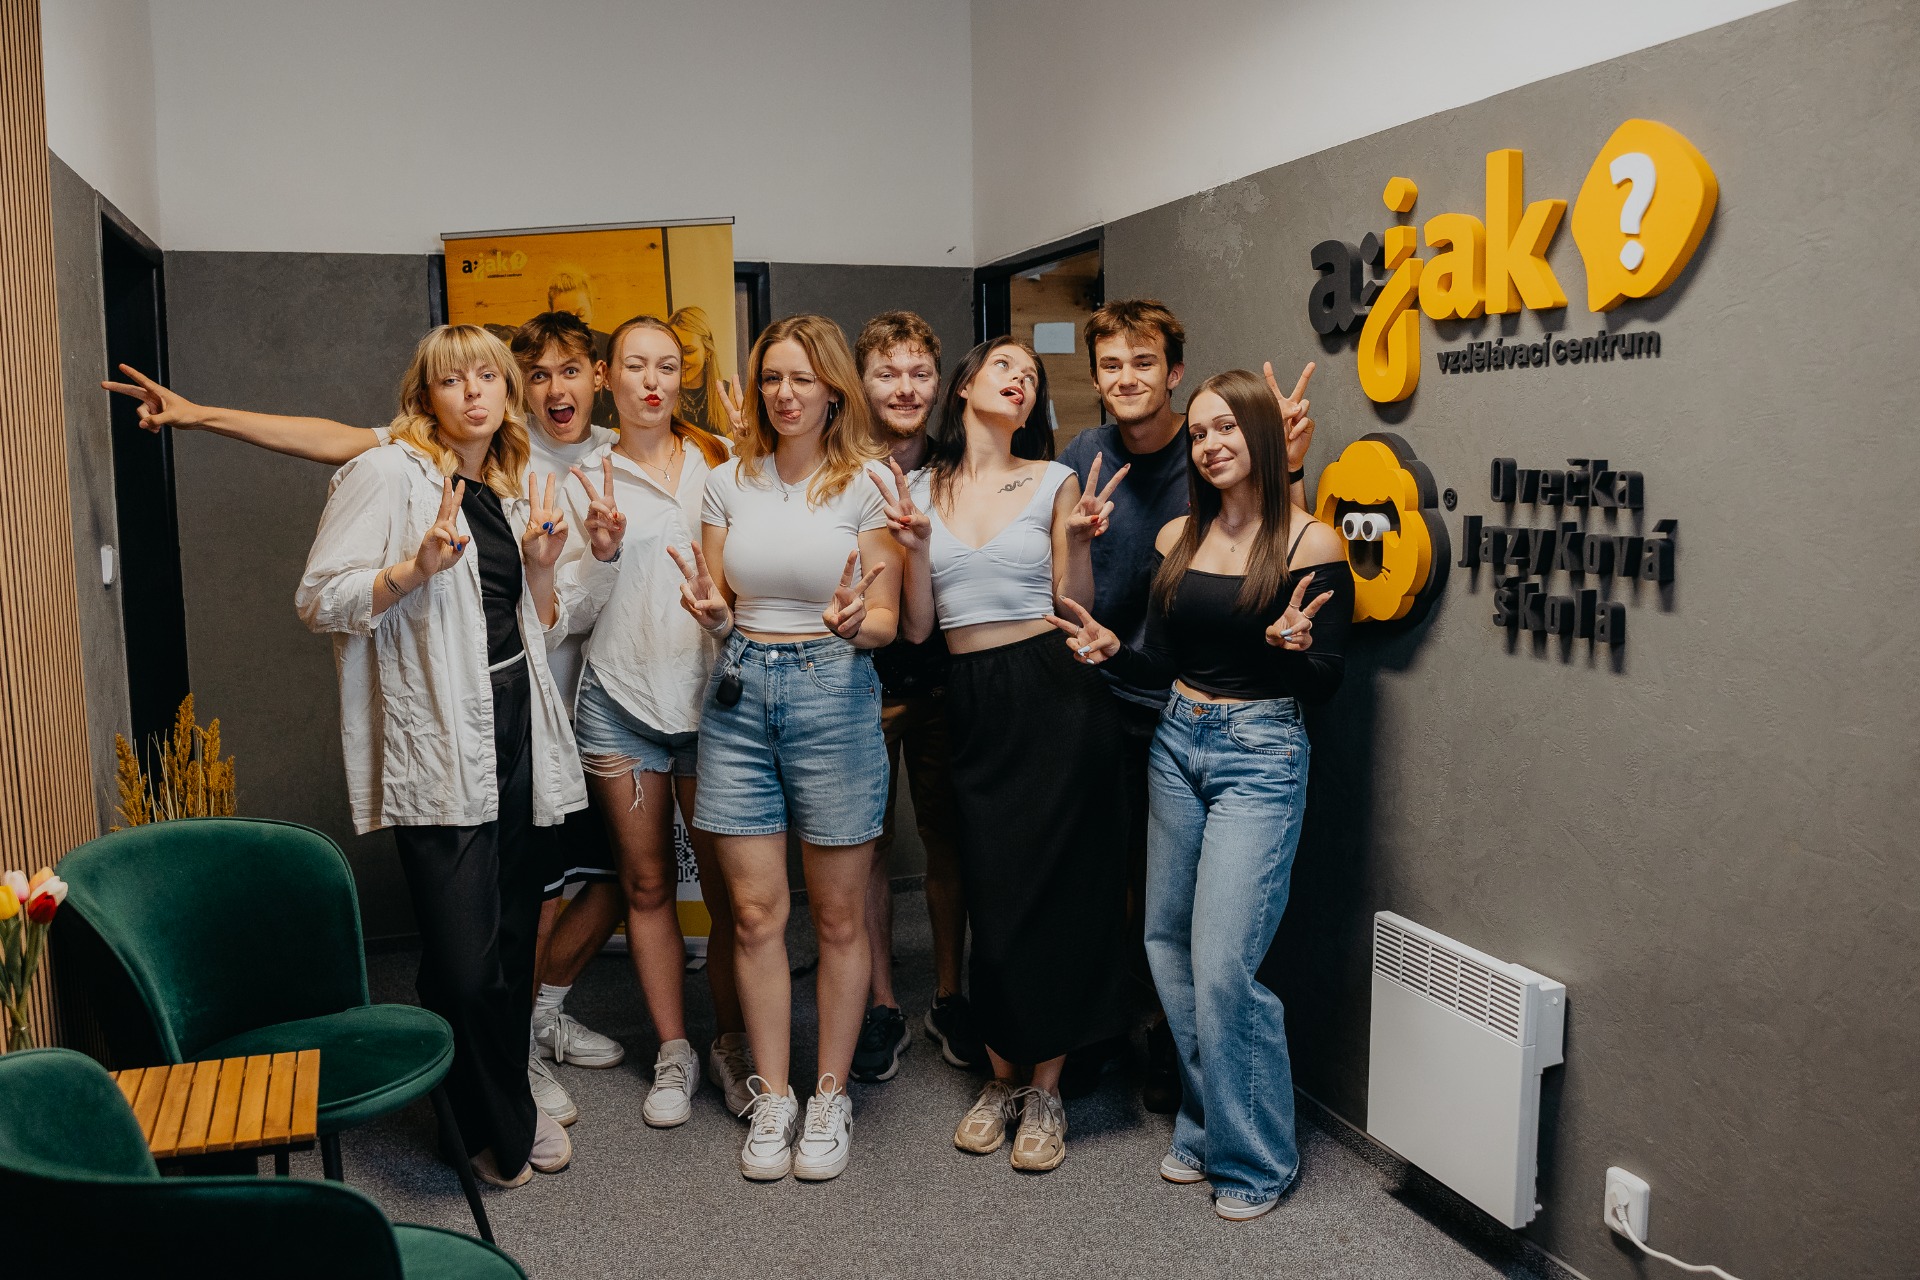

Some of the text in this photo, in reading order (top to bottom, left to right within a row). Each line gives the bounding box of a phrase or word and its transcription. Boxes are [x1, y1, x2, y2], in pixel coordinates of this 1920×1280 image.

[1437, 330, 1661, 374] vzdělávací centrum
[1491, 458, 1644, 509] Ovečka
[1458, 515, 1678, 582] Jazyková
